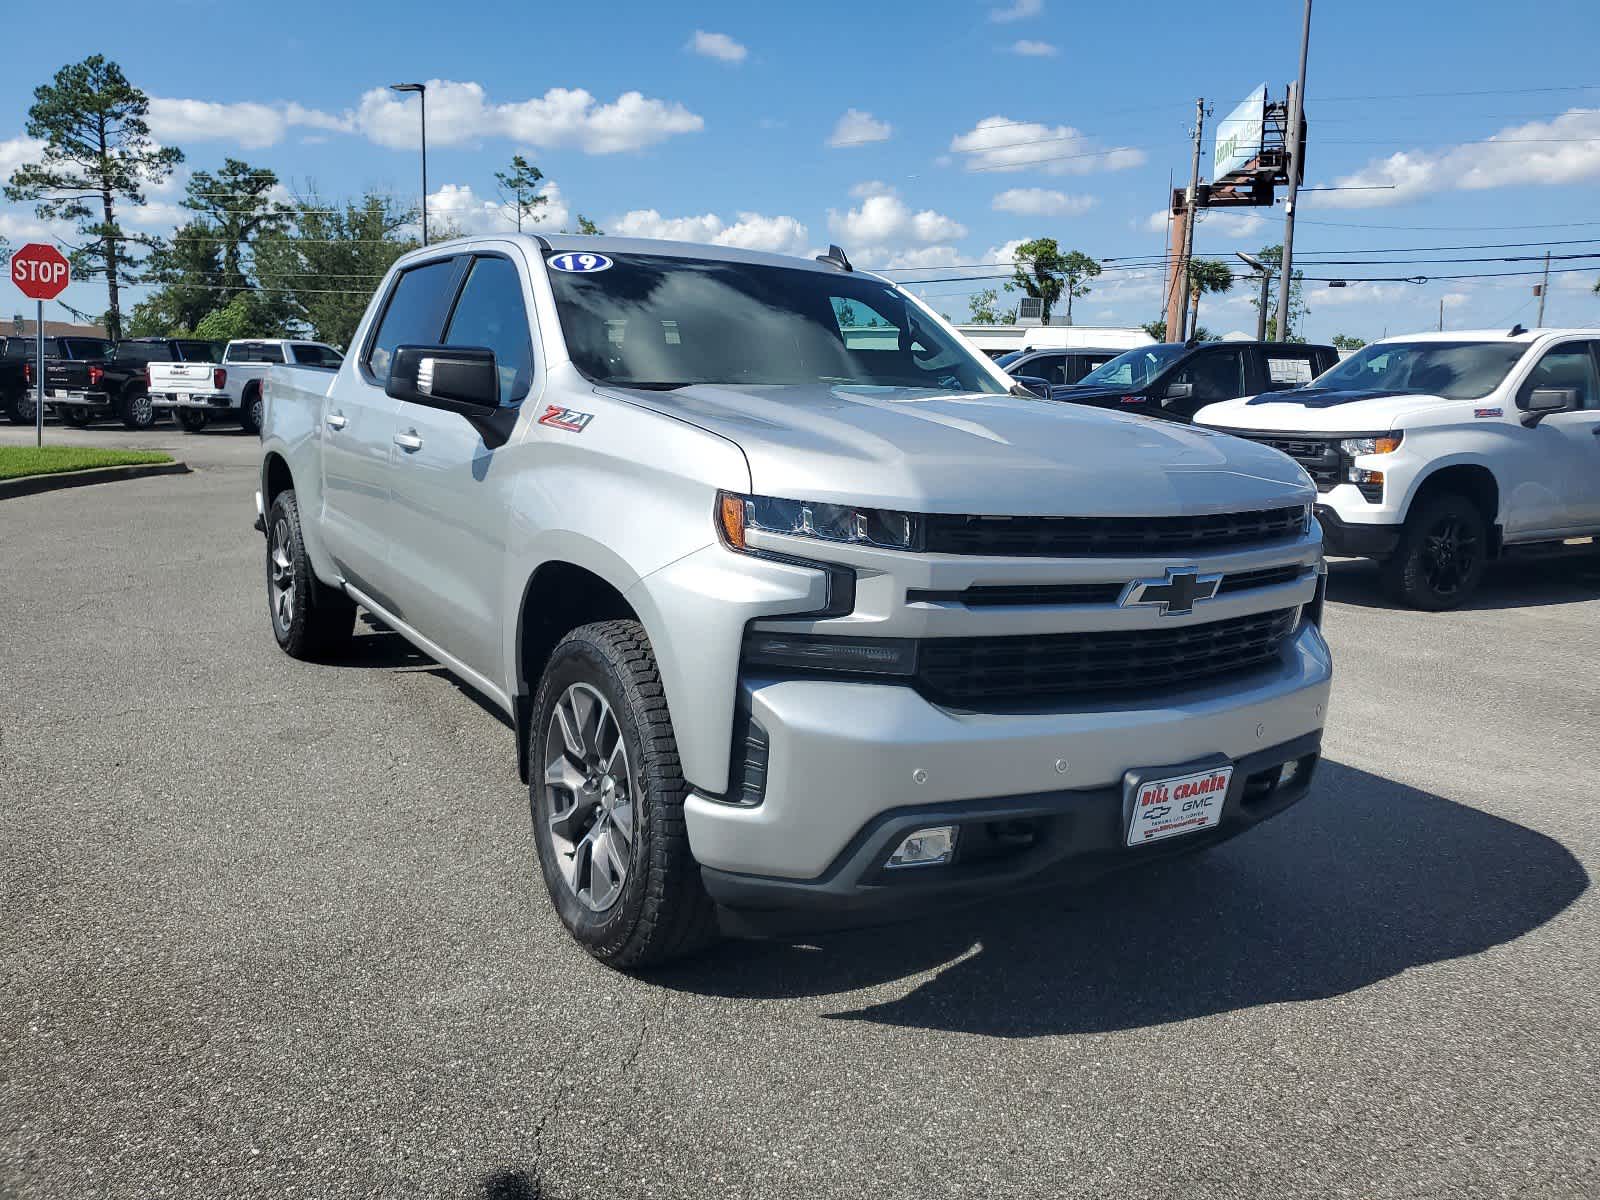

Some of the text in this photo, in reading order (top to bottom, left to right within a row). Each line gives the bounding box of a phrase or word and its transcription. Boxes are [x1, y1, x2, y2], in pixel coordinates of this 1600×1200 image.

[15, 260, 66, 283] STOP
[561, 255, 597, 270] 19
[538, 404, 594, 433] Z71
[1141, 775, 1226, 806] BILL CRAMER
[1182, 797, 1214, 811] GMC
